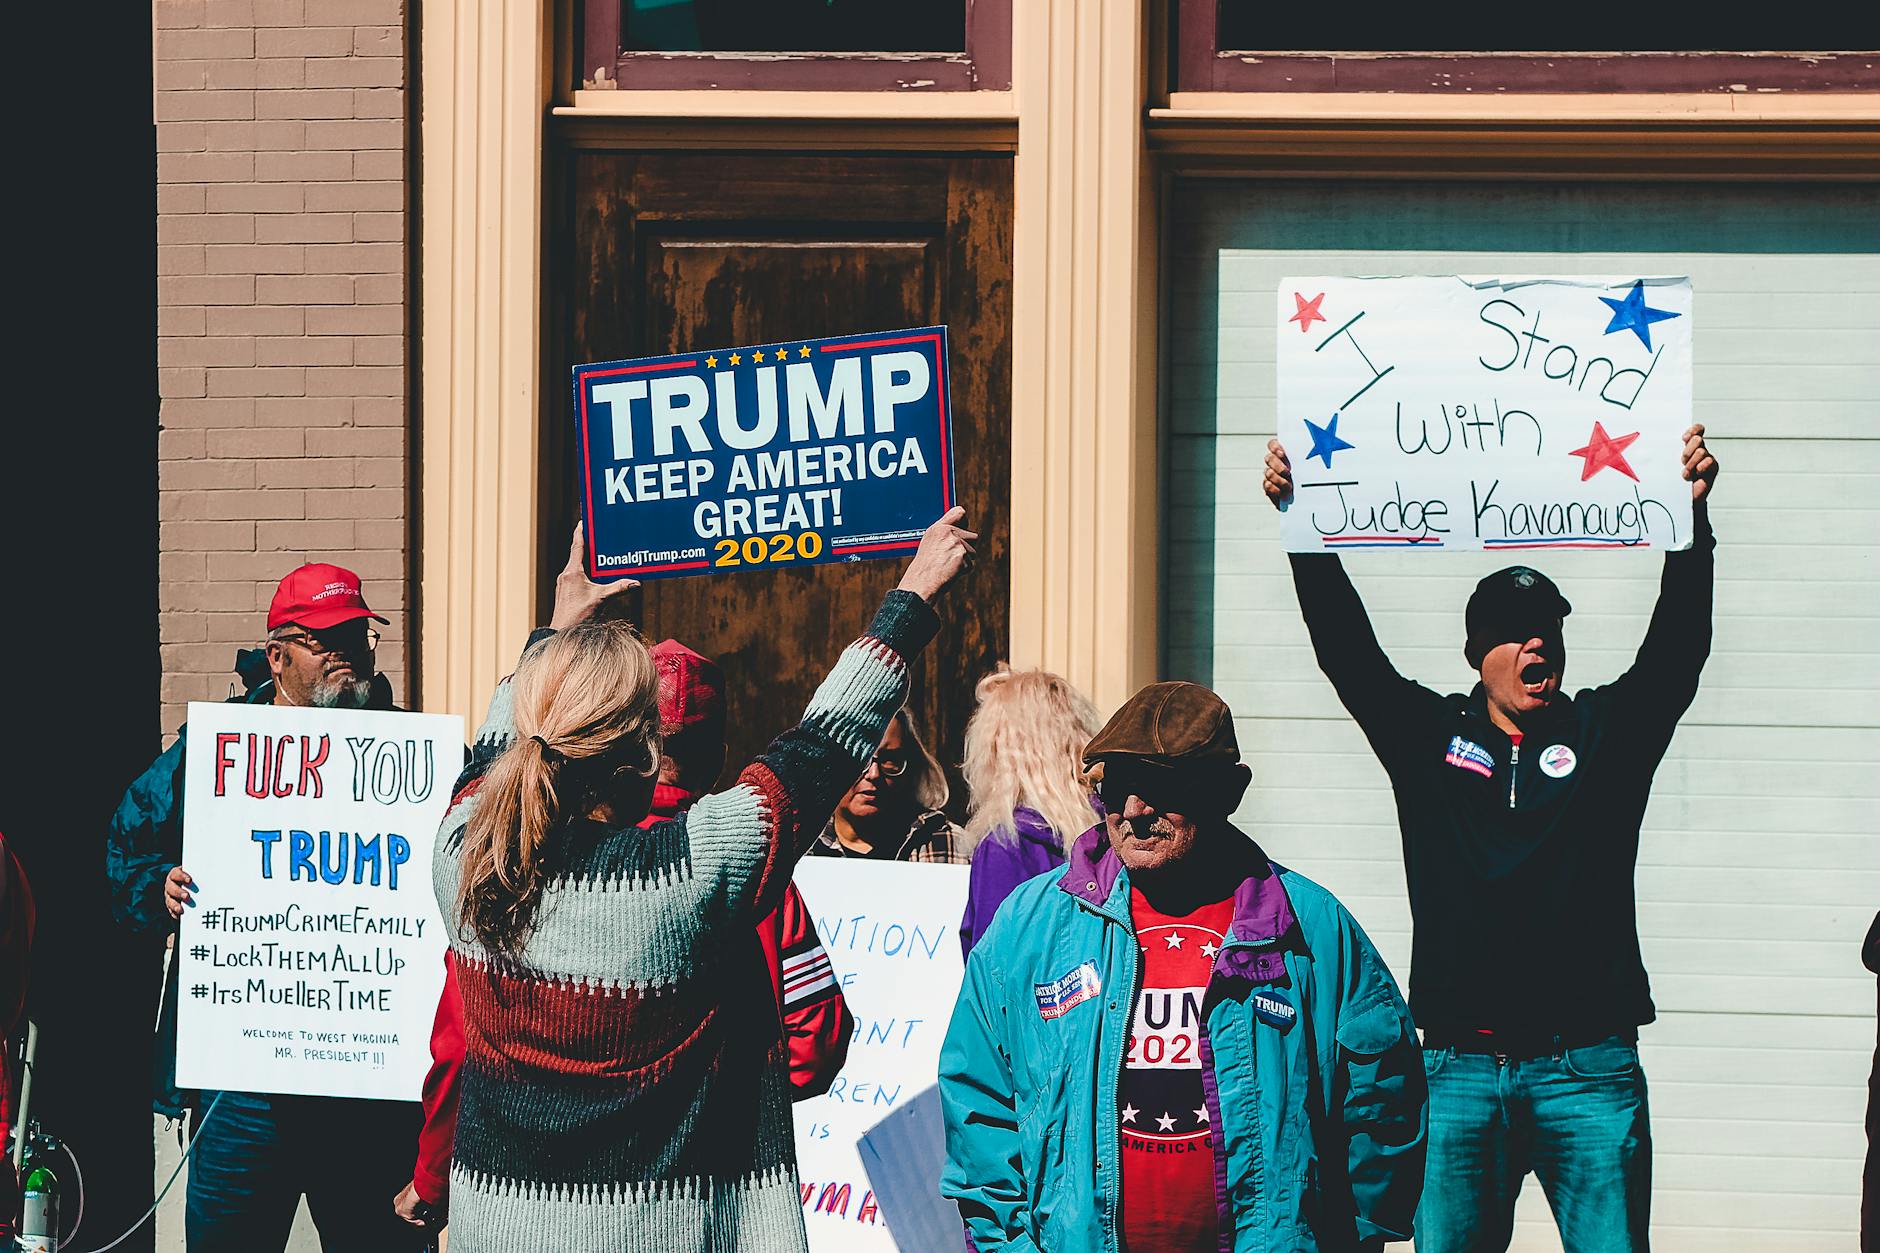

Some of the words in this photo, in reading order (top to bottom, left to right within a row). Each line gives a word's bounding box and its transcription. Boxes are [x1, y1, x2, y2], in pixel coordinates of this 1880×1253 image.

[1315, 311, 1395, 411] I
[1479, 299, 1665, 410] Stand
[592, 350, 931, 461] TRUMP
[1397, 398, 1543, 457] With
[604, 459, 714, 505] KEEP
[726, 437, 928, 494] AMERICA
[693, 488, 843, 539] GREAT!
[1301, 481, 1451, 544] Judge
[1470, 480, 1677, 546] Kavanaugh
[714, 531, 823, 567] 2020
[214, 733, 330, 799] FUCK
[346, 737, 433, 805] YOU
[251, 829, 411, 891] TRUMP
[1255, 995, 1296, 1018] TRUMP
[243, 1028, 294, 1041] WELCOME
[300, 1030, 313, 1042] TO
[316, 1032, 347, 1043] WEST
[352, 1033, 400, 1045] VIRGINIA
[275, 1047, 297, 1059] MR.
[304, 1048, 368, 1062] PRESIDENT
[810, 1123, 831, 1139] IS
[1122, 1136, 1198, 1154] AMERICA
